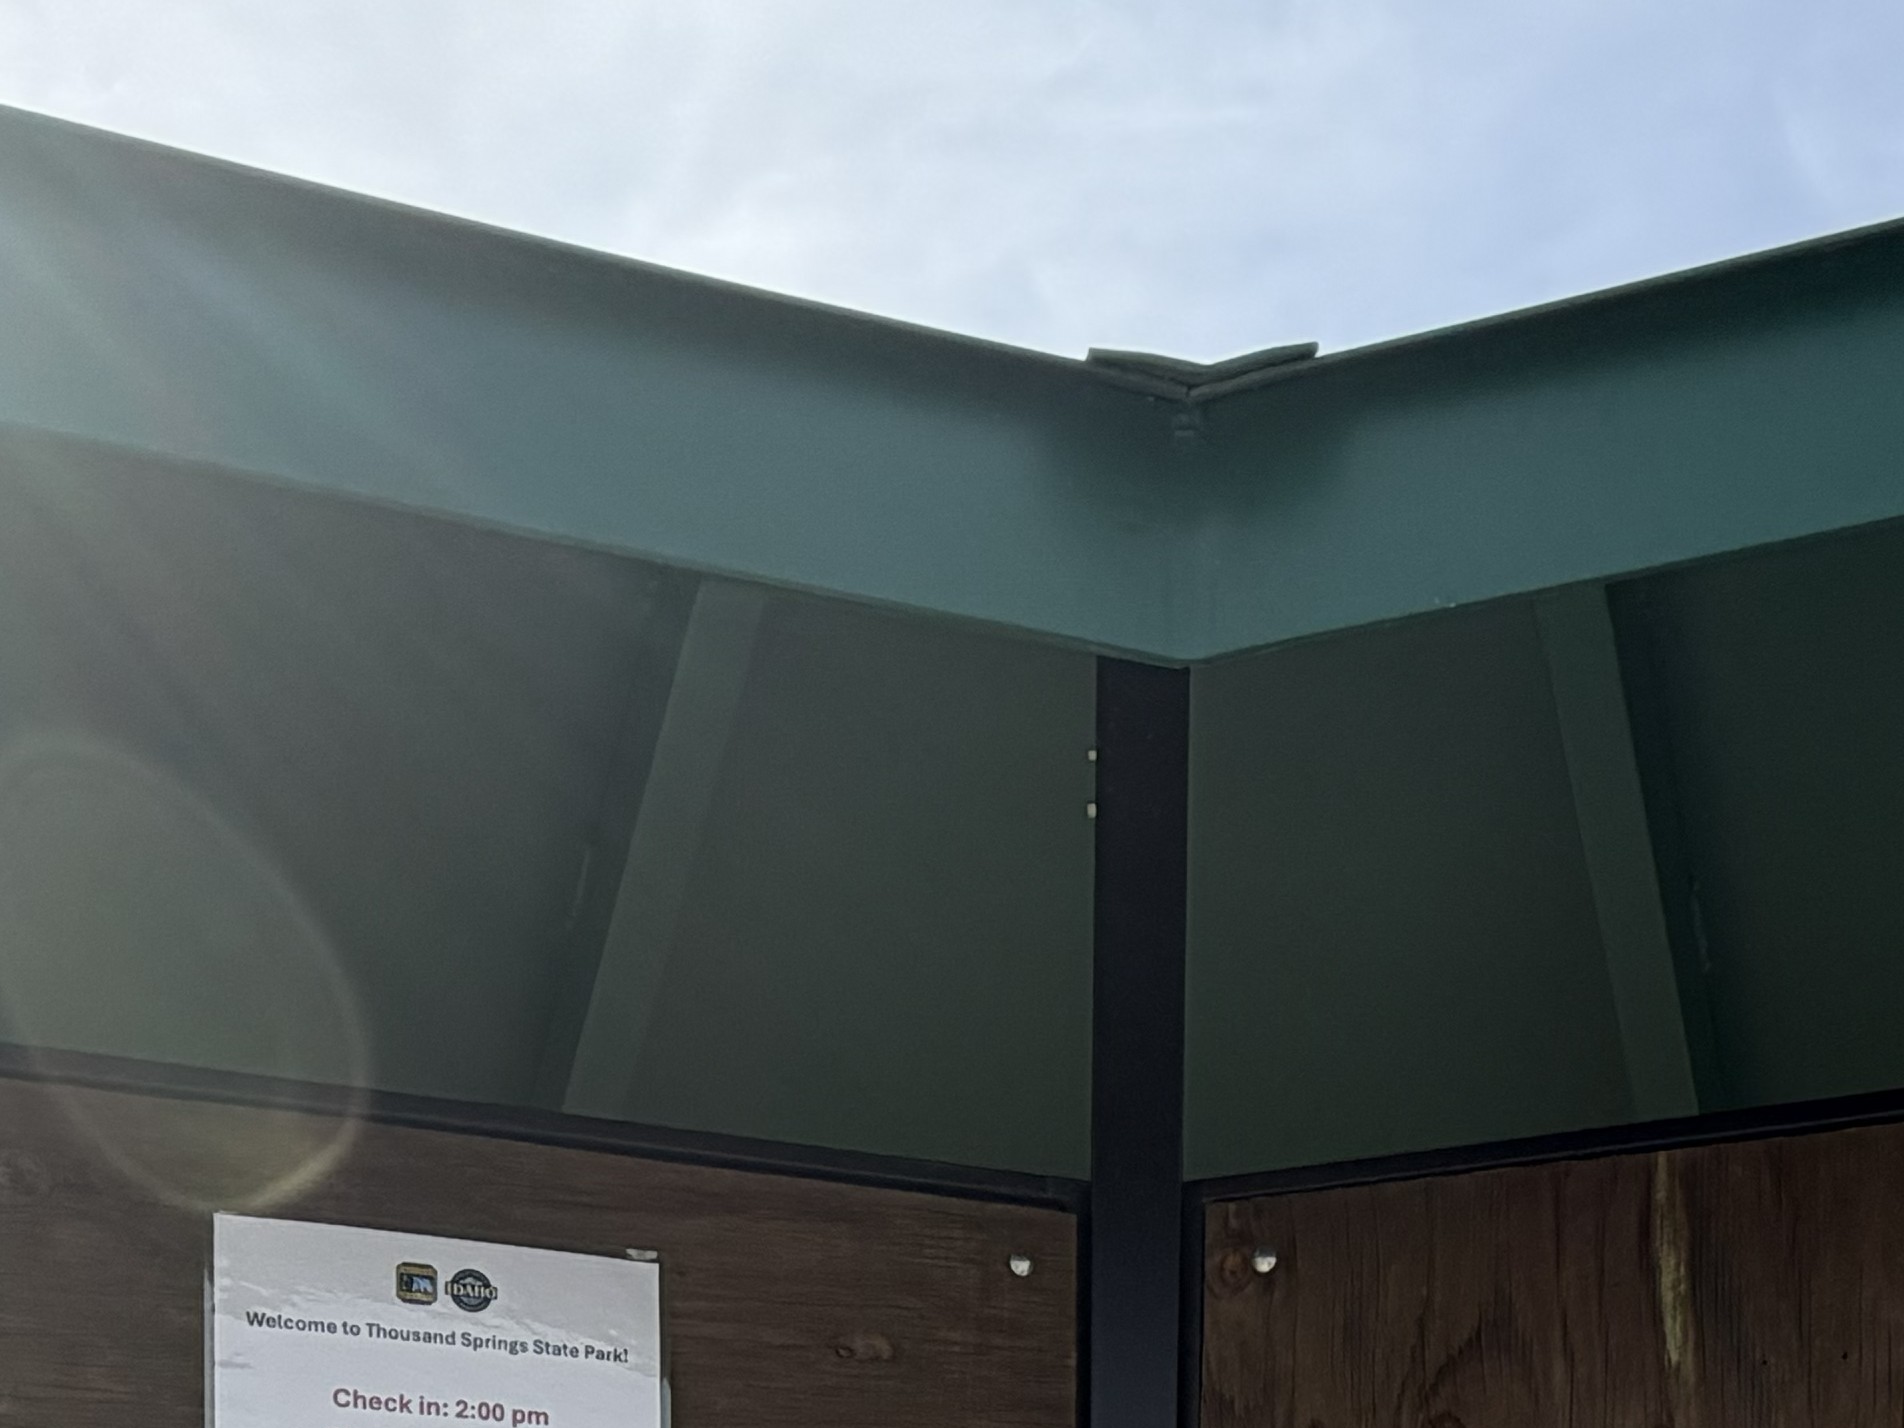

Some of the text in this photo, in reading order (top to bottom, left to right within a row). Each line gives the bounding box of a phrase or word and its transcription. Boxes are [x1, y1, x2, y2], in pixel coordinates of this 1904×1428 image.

[245, 1310, 628, 1363] Welcome to Thousand Springs State Park!
[332, 1388, 548, 1428] Check in: 2:00 pm
